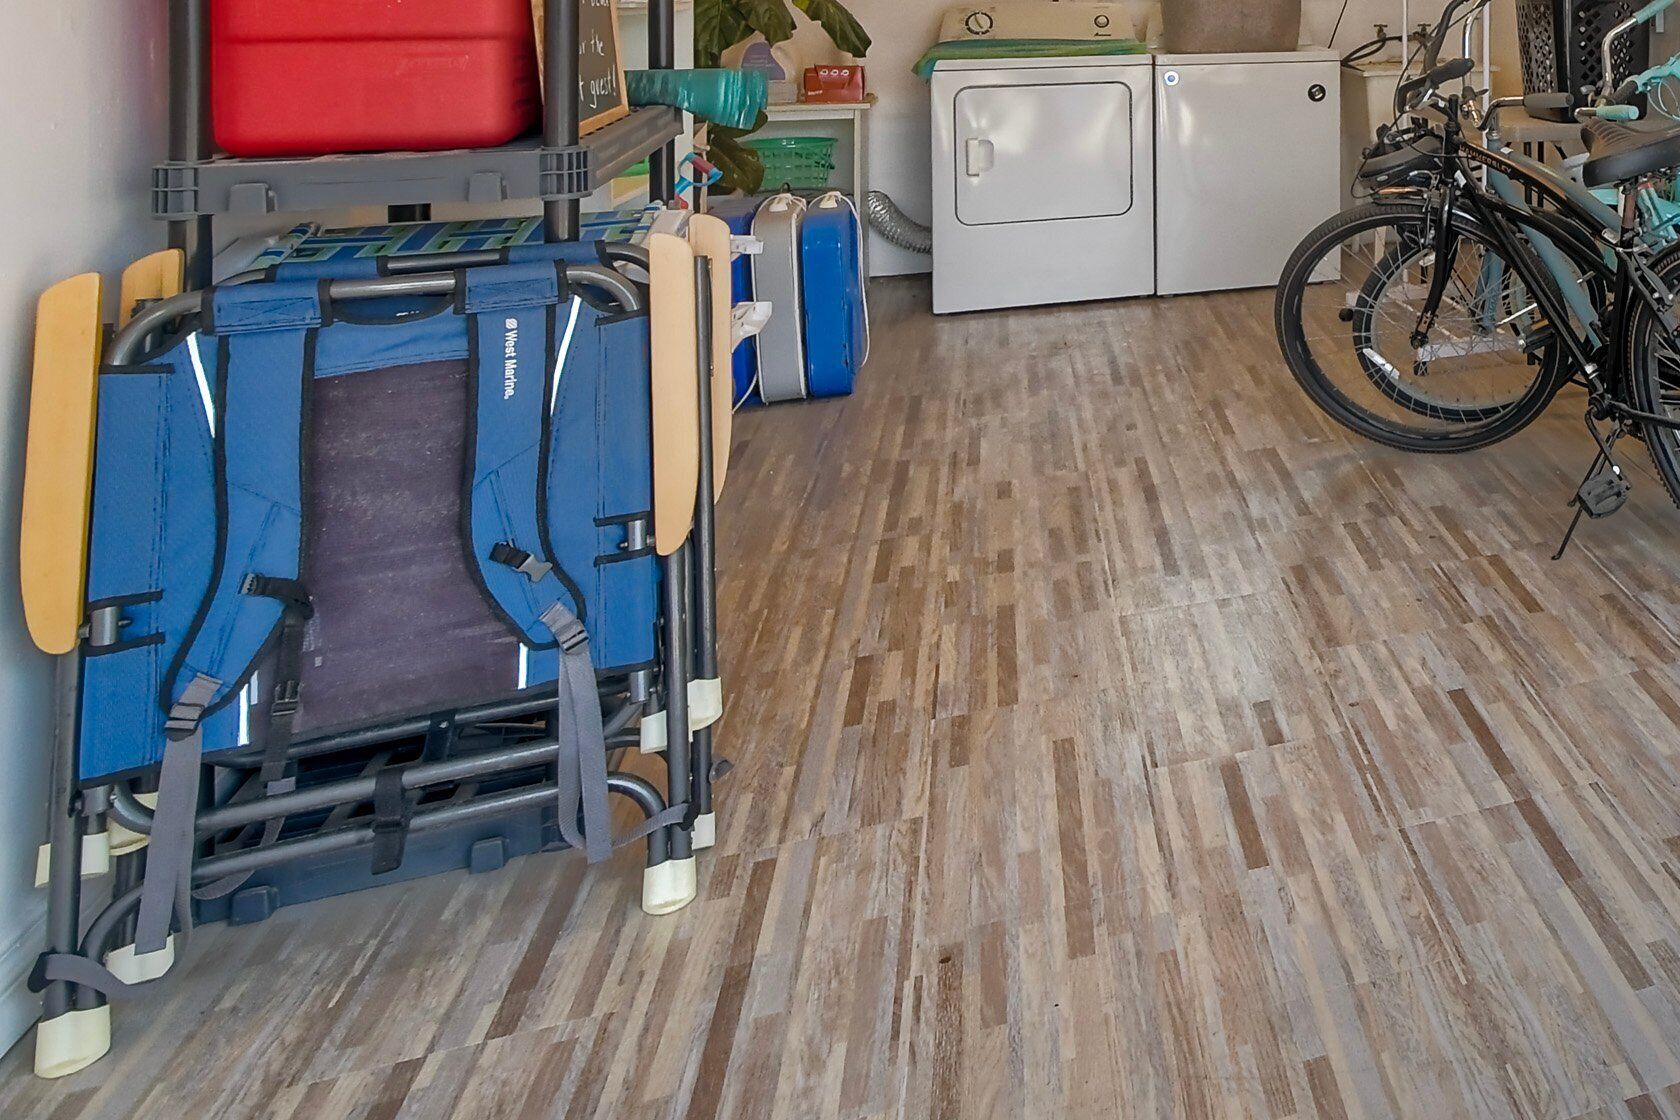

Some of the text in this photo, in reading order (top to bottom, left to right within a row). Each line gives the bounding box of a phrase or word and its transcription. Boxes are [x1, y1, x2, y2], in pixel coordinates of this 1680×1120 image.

[590, 28, 605, 56] the
[590, 64, 616, 109] guest!
[504, 330, 518, 397] West Marine
